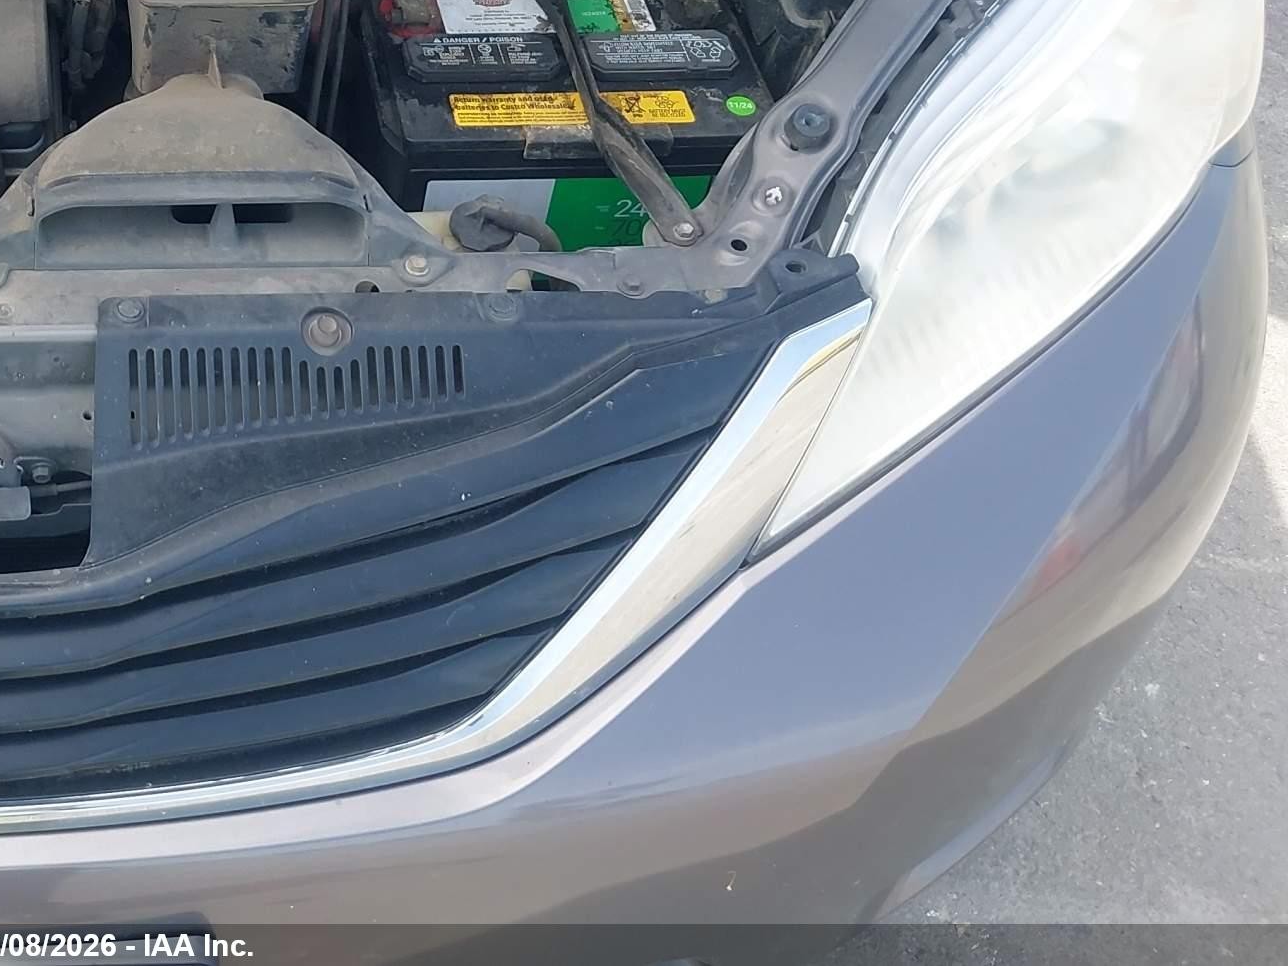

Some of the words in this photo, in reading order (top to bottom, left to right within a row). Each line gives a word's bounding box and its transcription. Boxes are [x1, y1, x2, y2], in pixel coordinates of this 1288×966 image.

[481, 96, 516, 105] warranty
[455, 103, 491, 111] batteries
[500, 103, 526, 111] Costco
